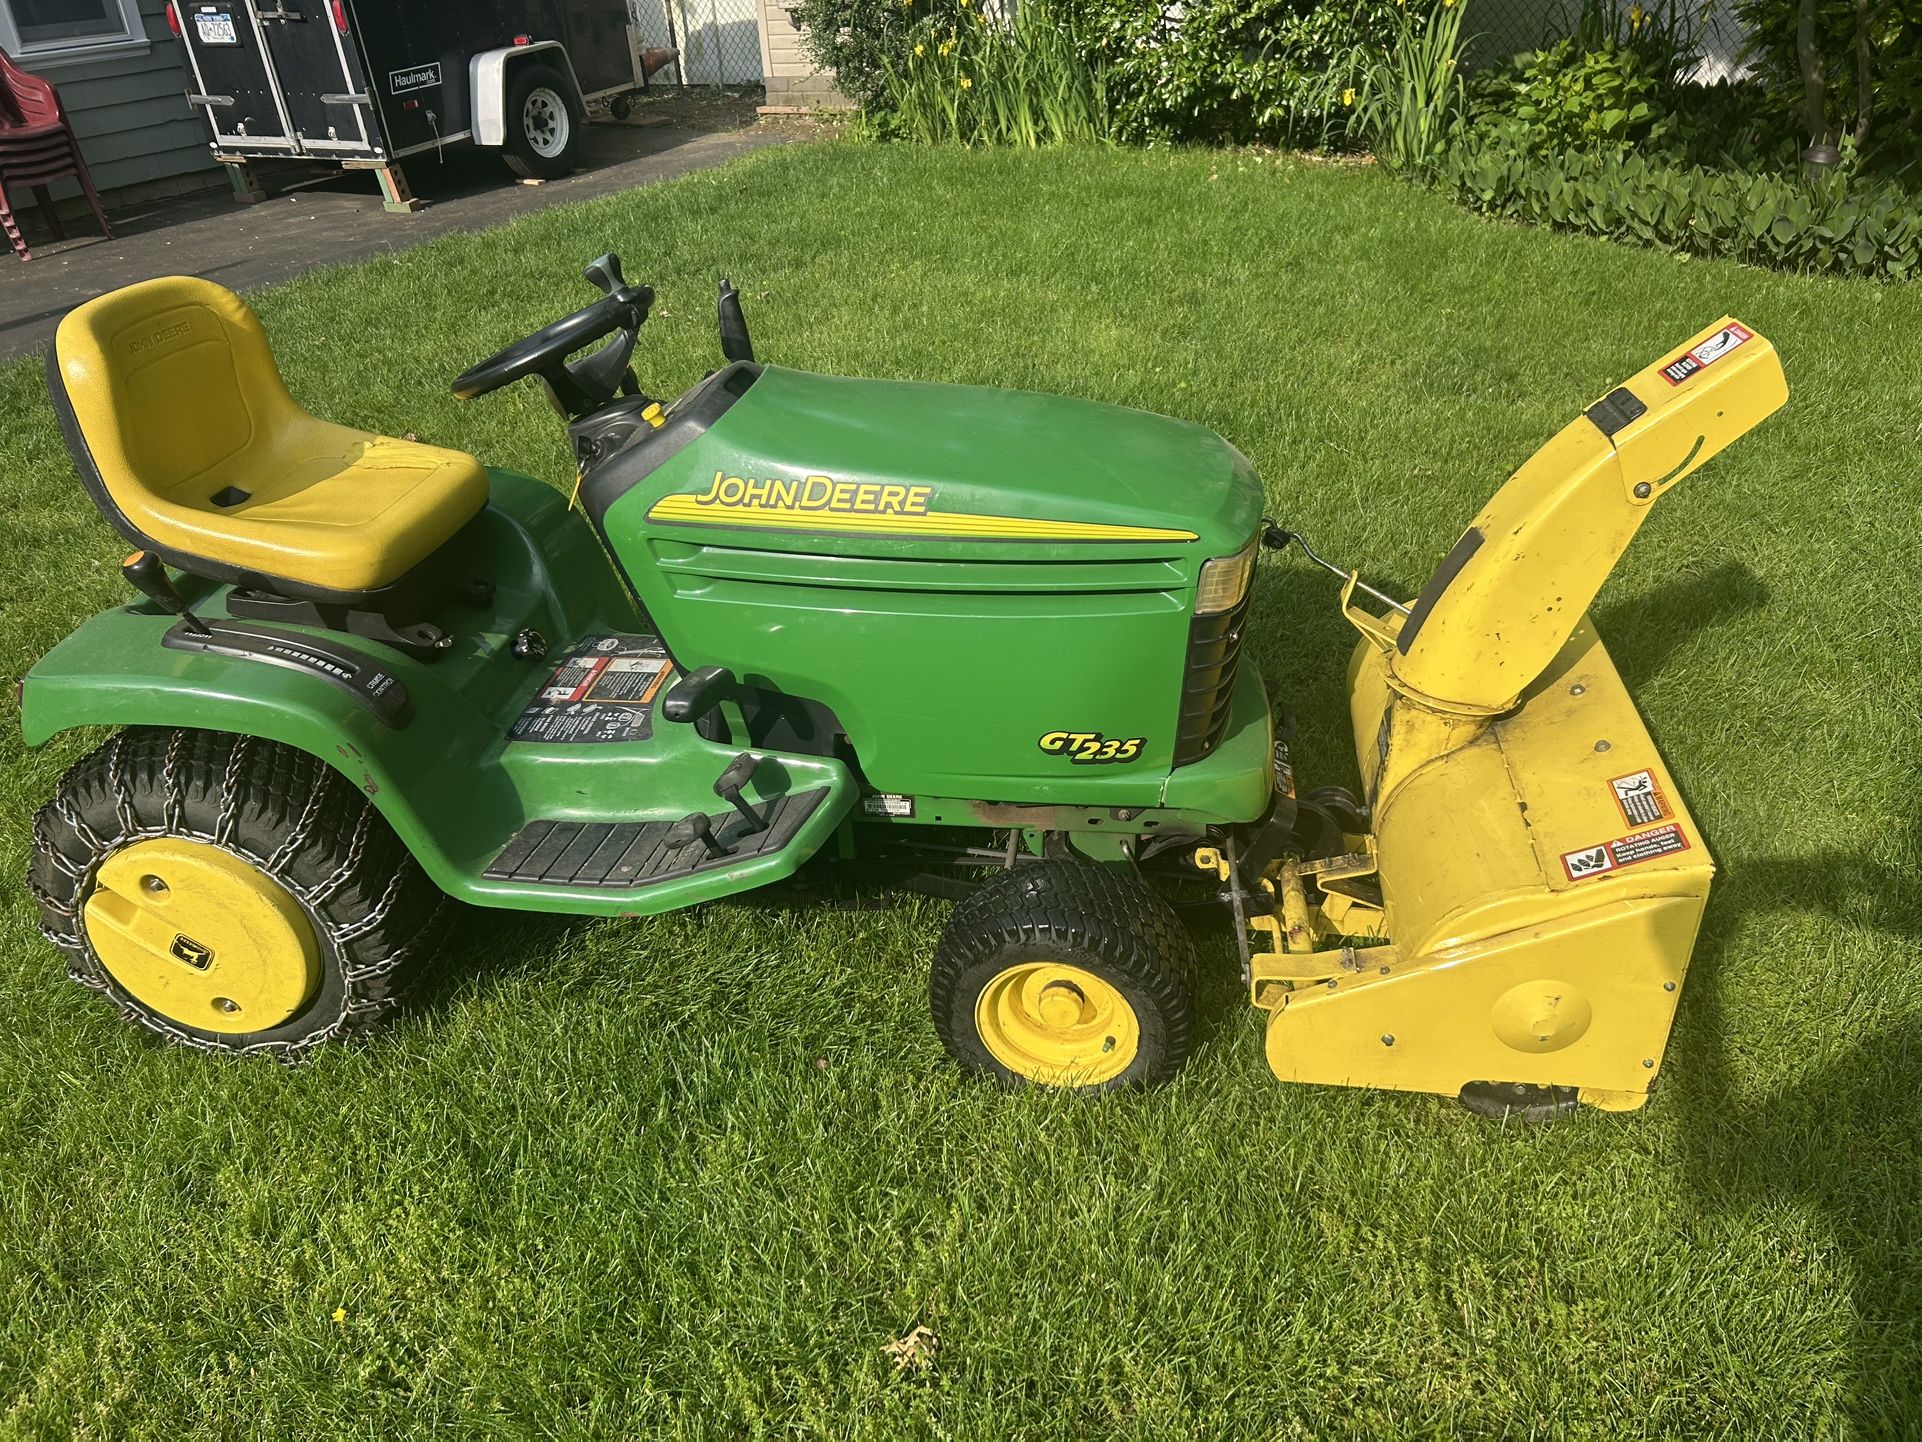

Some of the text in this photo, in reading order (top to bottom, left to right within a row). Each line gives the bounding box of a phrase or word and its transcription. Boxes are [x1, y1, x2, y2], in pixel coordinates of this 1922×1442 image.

[394, 68, 435, 87] Haulmark
[128, 321, 191, 354] JOHN DEERE
[695, 471, 934, 514] JOHN DEERE
[366, 672, 386, 689] CRUISE
[372, 677, 395, 697] CONTROL
[1038, 731, 1146, 763] GT235
[1656, 794, 1671, 817] WARNING
[1616, 832, 1676, 852] ROTATING AUGER
[1626, 825, 1676, 843] DANGER
[1616, 848, 1635, 858] Keep
[1633, 847, 1662, 859] clothing
